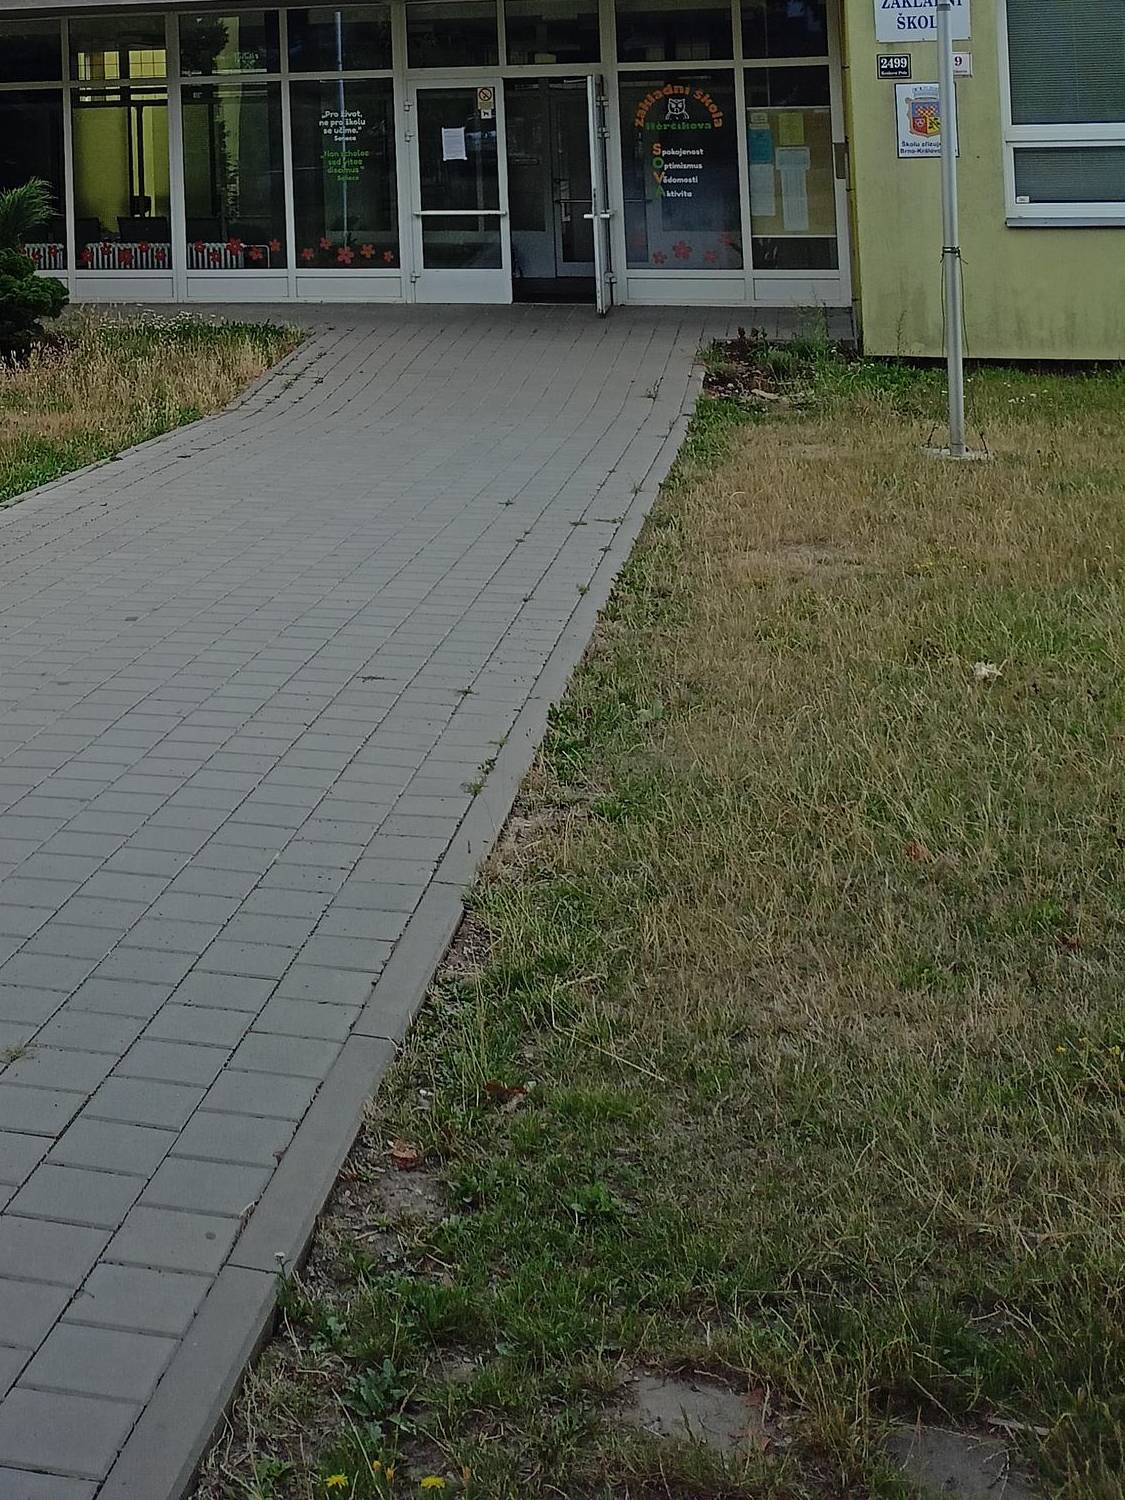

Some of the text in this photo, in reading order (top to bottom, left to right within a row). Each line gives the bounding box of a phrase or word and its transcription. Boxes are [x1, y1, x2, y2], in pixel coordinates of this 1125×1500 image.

[897, 13, 938, 29] ŠKOL
[881, 57, 908, 68] 2499
[330, 120, 343, 128] pro
